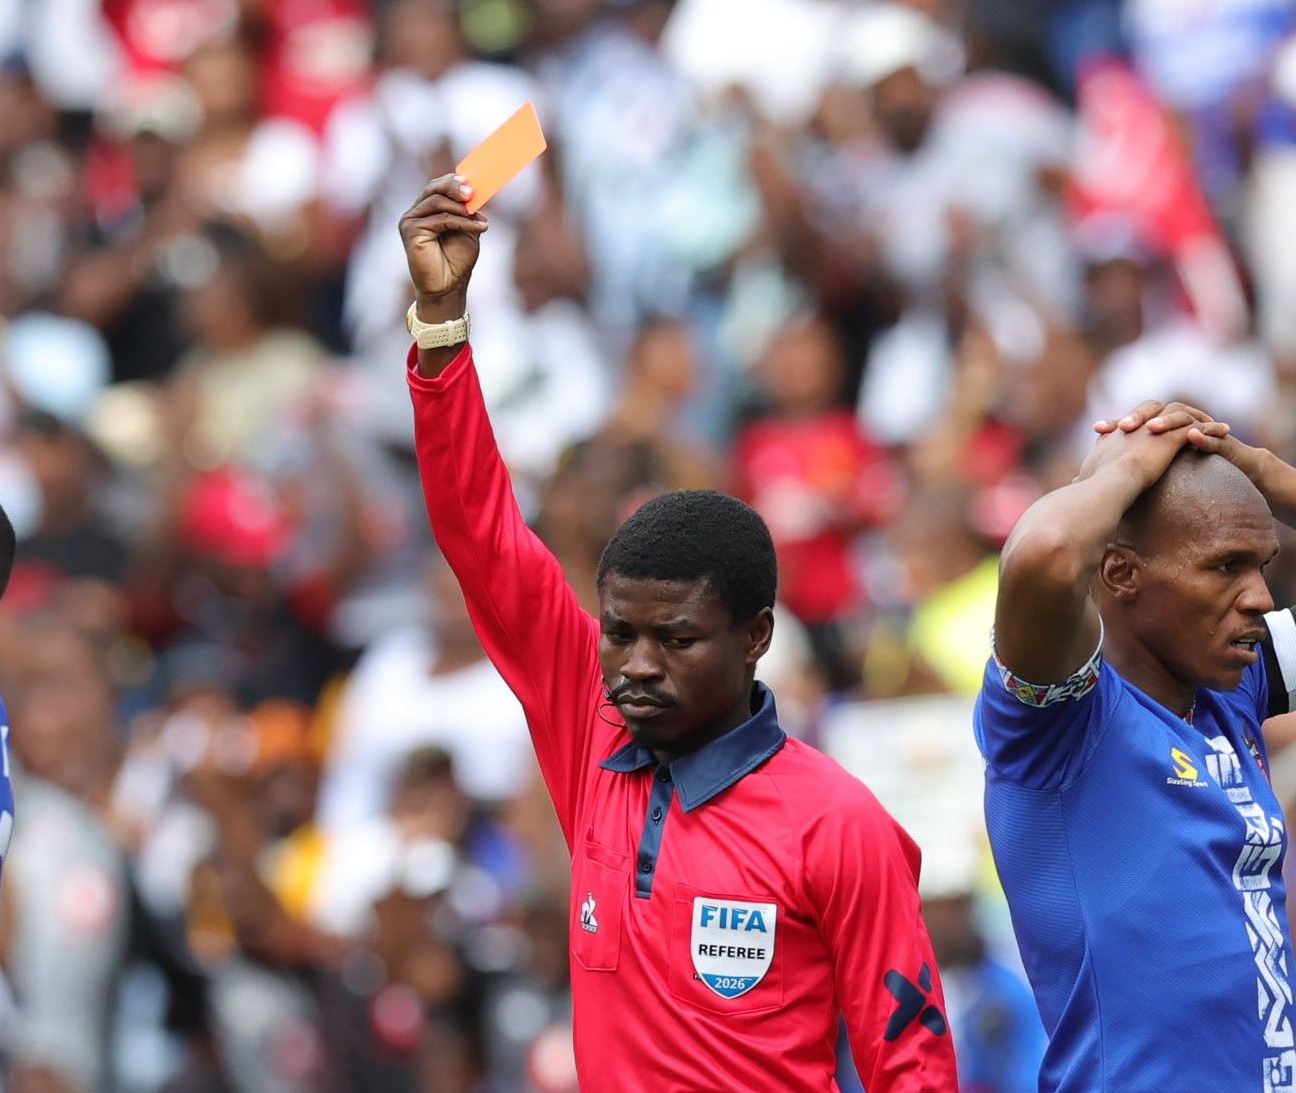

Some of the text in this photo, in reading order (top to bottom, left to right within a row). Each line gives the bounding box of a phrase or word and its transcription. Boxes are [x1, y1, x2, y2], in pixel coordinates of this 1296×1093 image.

[700, 904, 768, 934] FIFA
[698, 944, 766, 960] REFEREE
[714, 977, 746, 990] 2026
